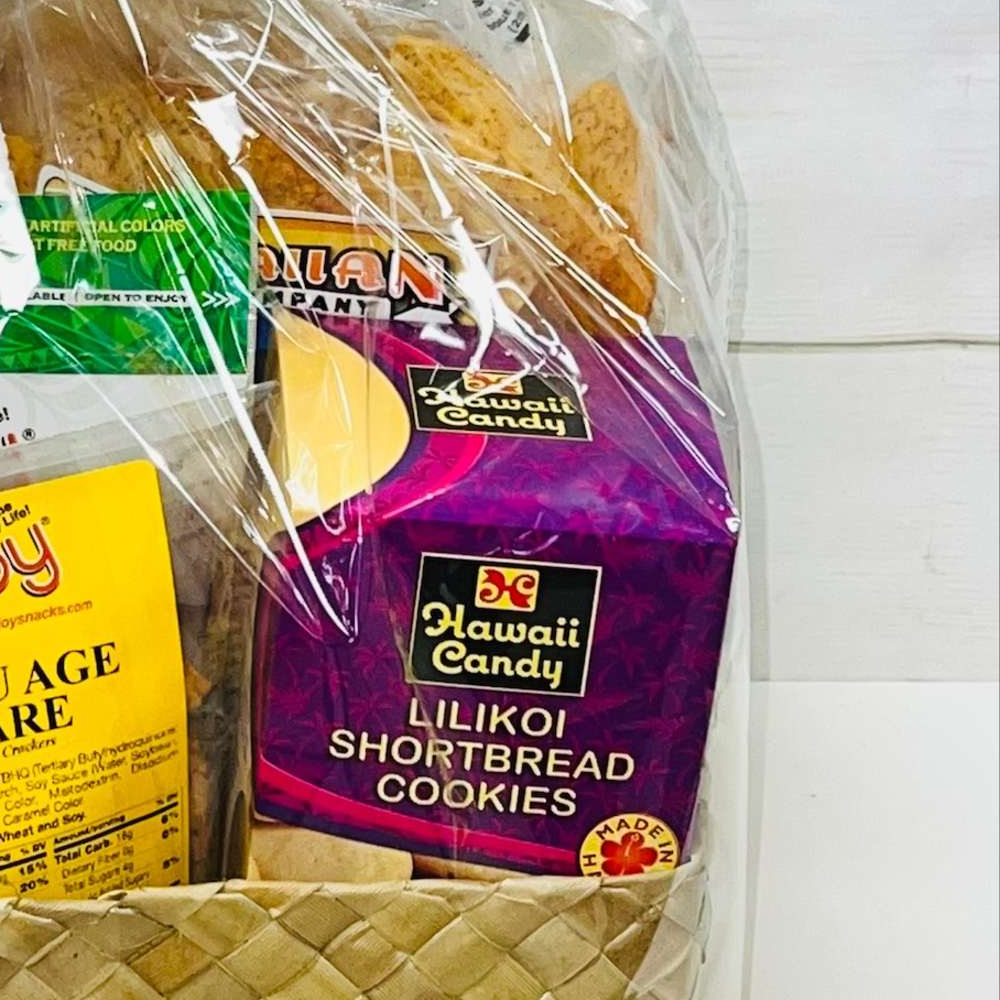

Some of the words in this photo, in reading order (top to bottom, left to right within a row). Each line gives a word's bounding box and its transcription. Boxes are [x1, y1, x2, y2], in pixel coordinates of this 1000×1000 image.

[29, 219, 118, 233] ARTIFIAL
[120, 218, 186, 233] COLORS
[85, 292, 121, 302] OPEN
[124, 293, 142, 302] TO
[417, 386, 576, 415] Hawaii
[436, 406, 567, 437] Candy
[3, 504, 32, 527] Life!
[421, 600, 581, 649] Hawaii
[24, 641, 121, 696] AGE
[431, 639, 564, 690] Candy
[407, 696, 567, 740] LILIKOI
[3, 738, 57, 758] Crackers
[328, 727, 636, 782] SHORTBREAD
[25, 780, 49, 793] Soy
[52, 769, 89, 786] Sauce
[376, 772, 578, 818] COOKIES
[3, 805, 50, 826] Caramel
[37, 817, 60, 833] and
[595, 818, 665, 841] MADE
[657, 840, 675, 864] IN
[54, 848, 82, 865] Total
